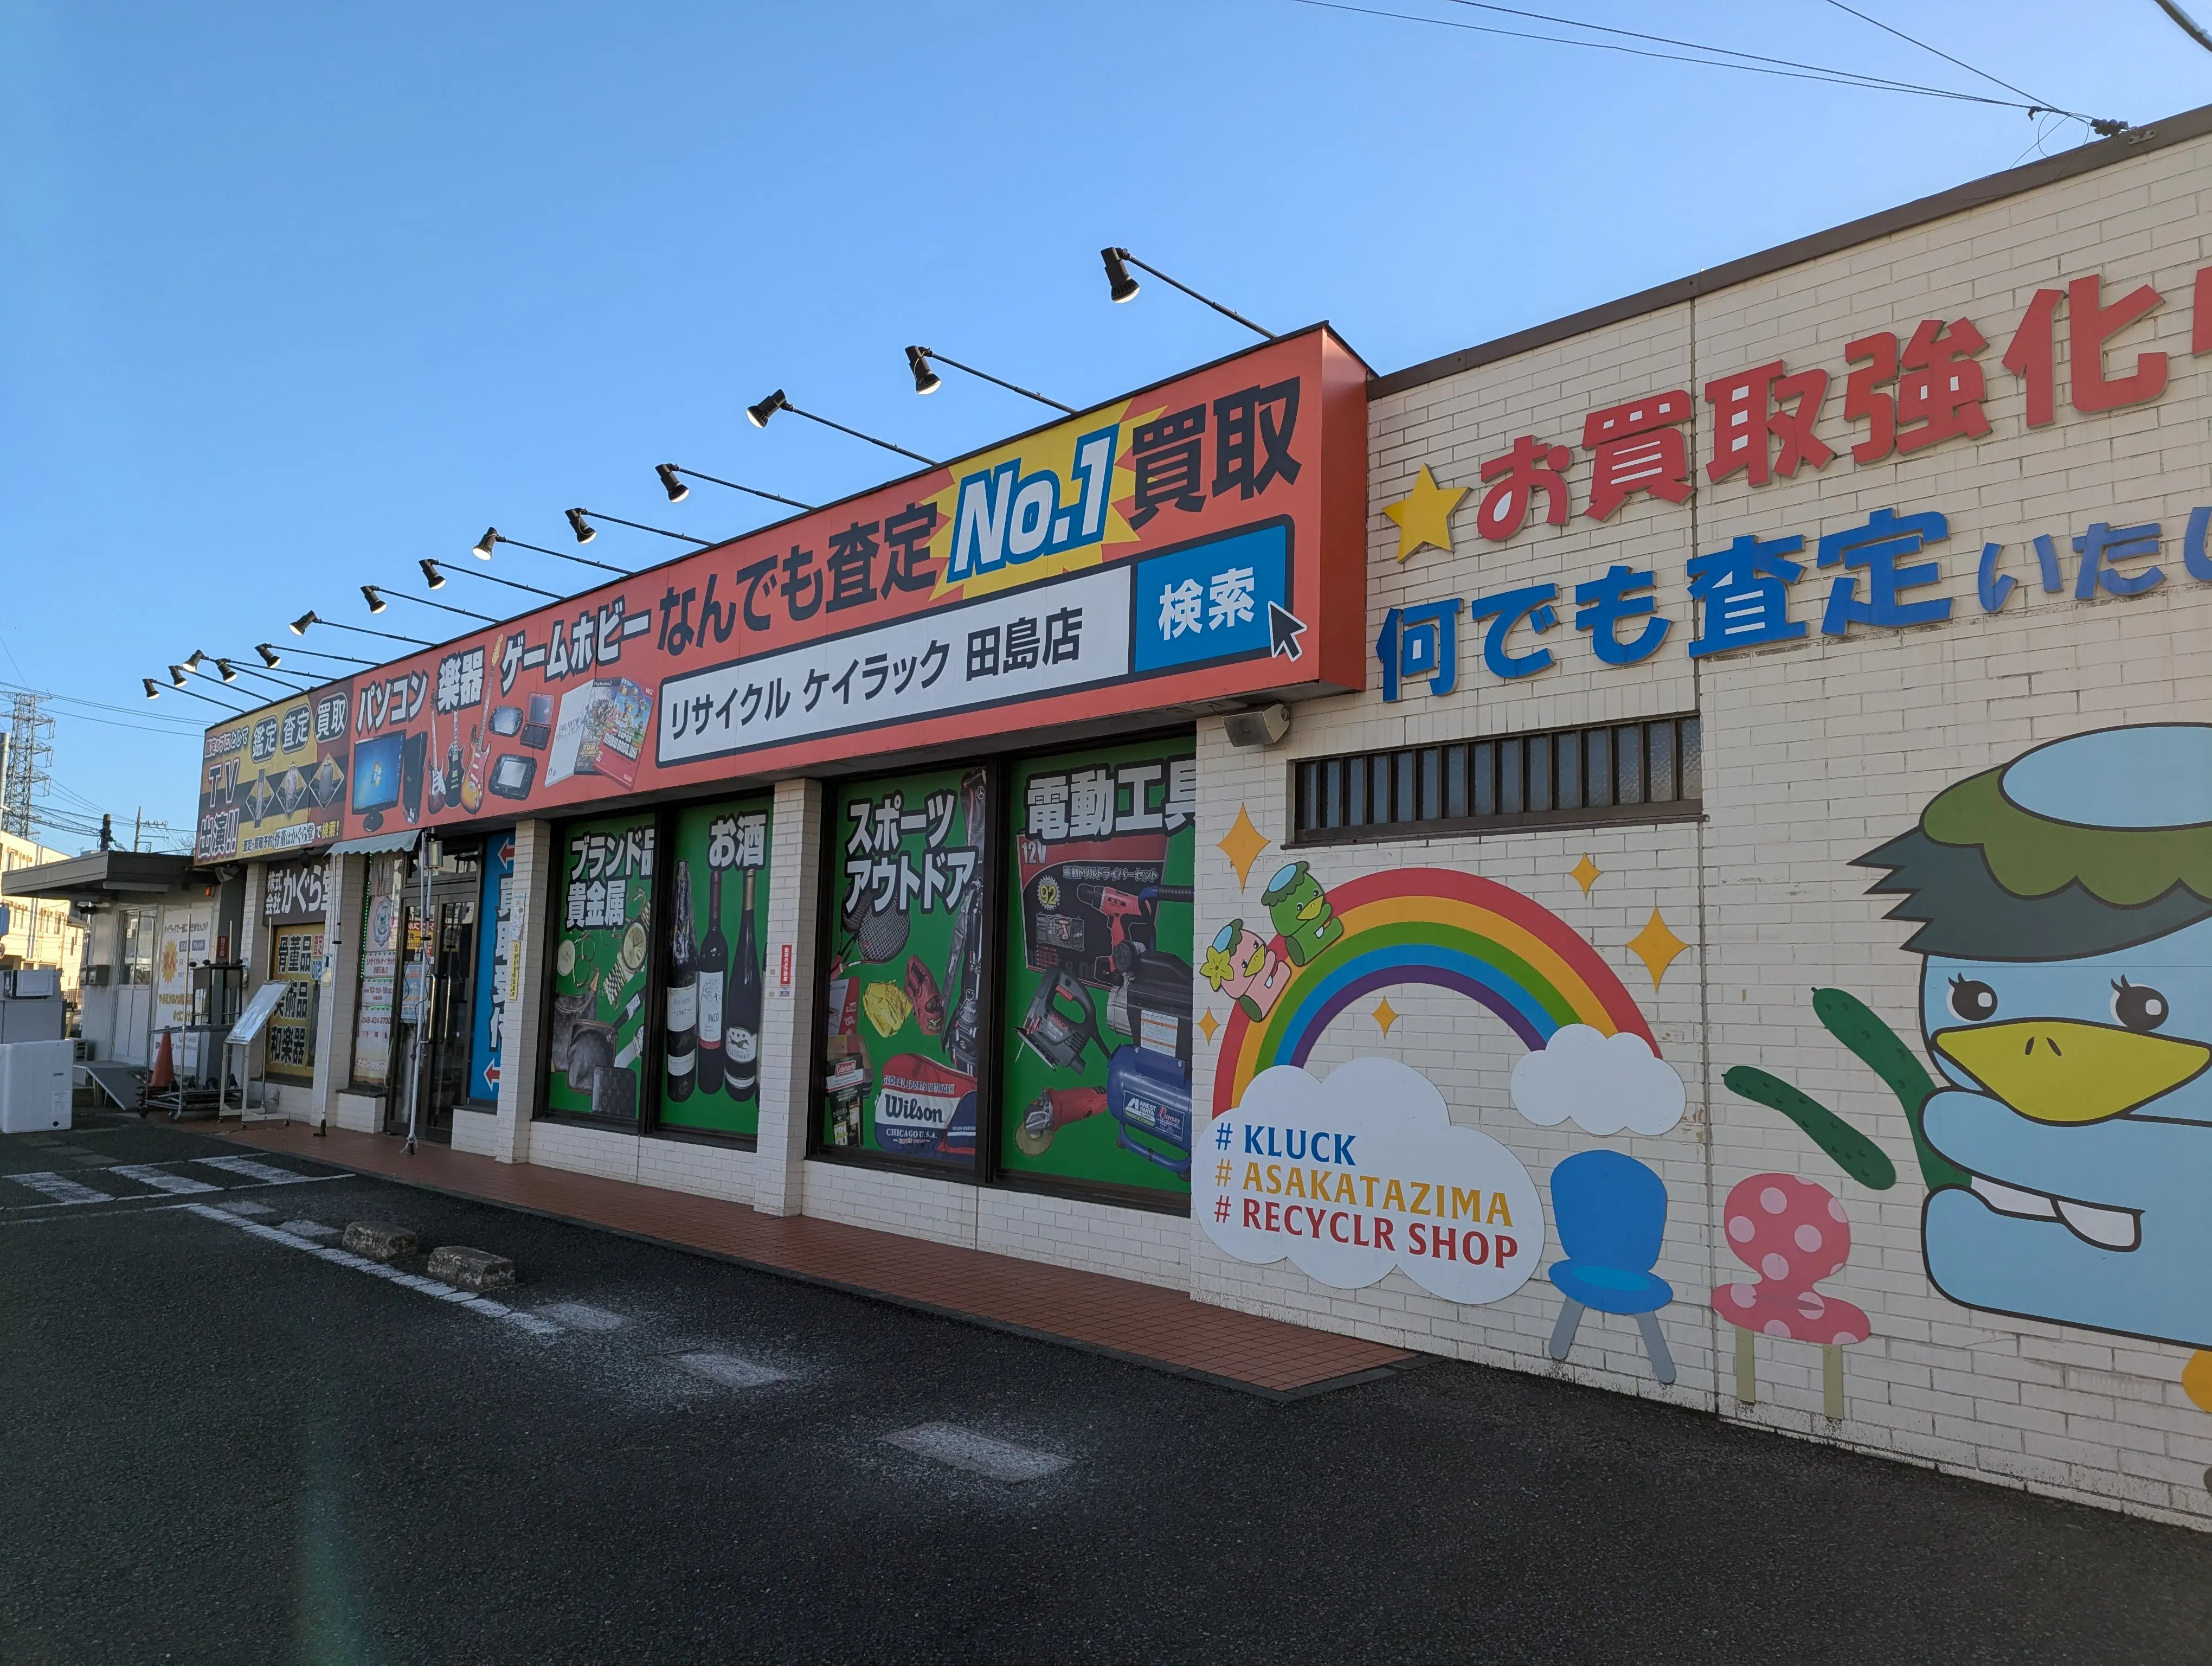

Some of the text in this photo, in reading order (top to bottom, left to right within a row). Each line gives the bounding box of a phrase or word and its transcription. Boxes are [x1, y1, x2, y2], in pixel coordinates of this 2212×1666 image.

[1476, 267, 2212, 542] お買取強化
[657, 376, 1302, 656] なんでも査定 No.1 買取
[1159, 567, 1255, 640] 検索
[501, 598, 650, 694] ゲームホビー
[438, 647, 485, 713] 楽器
[671, 607, 1083, 740] リサイクル ケイラック 田島店
[253, 699, 346, 757] 鑑定 査定 買取
[357, 671, 428, 735] パソコン
[209, 759, 240, 808] TV
[709, 814, 766, 867] お酒
[847, 794, 954, 855] スポーツ
[1021, 841, 1046, 864] 12V
[1063, 866, 1159, 882] 電動ドリルドライバーセット
[567, 880, 626, 928] 貴金属
[845, 851, 975, 913] アウトドア
[1040, 885, 1057, 905] 92
[278, 935, 312, 973] 骨董品
[312, 960, 323, 979] 012
[271, 1025, 305, 1066] 和楽器
[883, 1075, 955, 1094] GLOBAL SPORTS NETWORK
[885, 1093, 943, 1123] Wilson
[1139, 1101, 1156, 1111] ANEST
[886, 1128, 918, 1138] CHICAGO
[1244, 1124, 1357, 1166] KLUCK
[1243, 1161, 1513, 1227] ASAKATAZIMA
[1243, 1197, 1396, 1251] RECYCLR
[1409, 1222, 1518, 1269] SHOP
